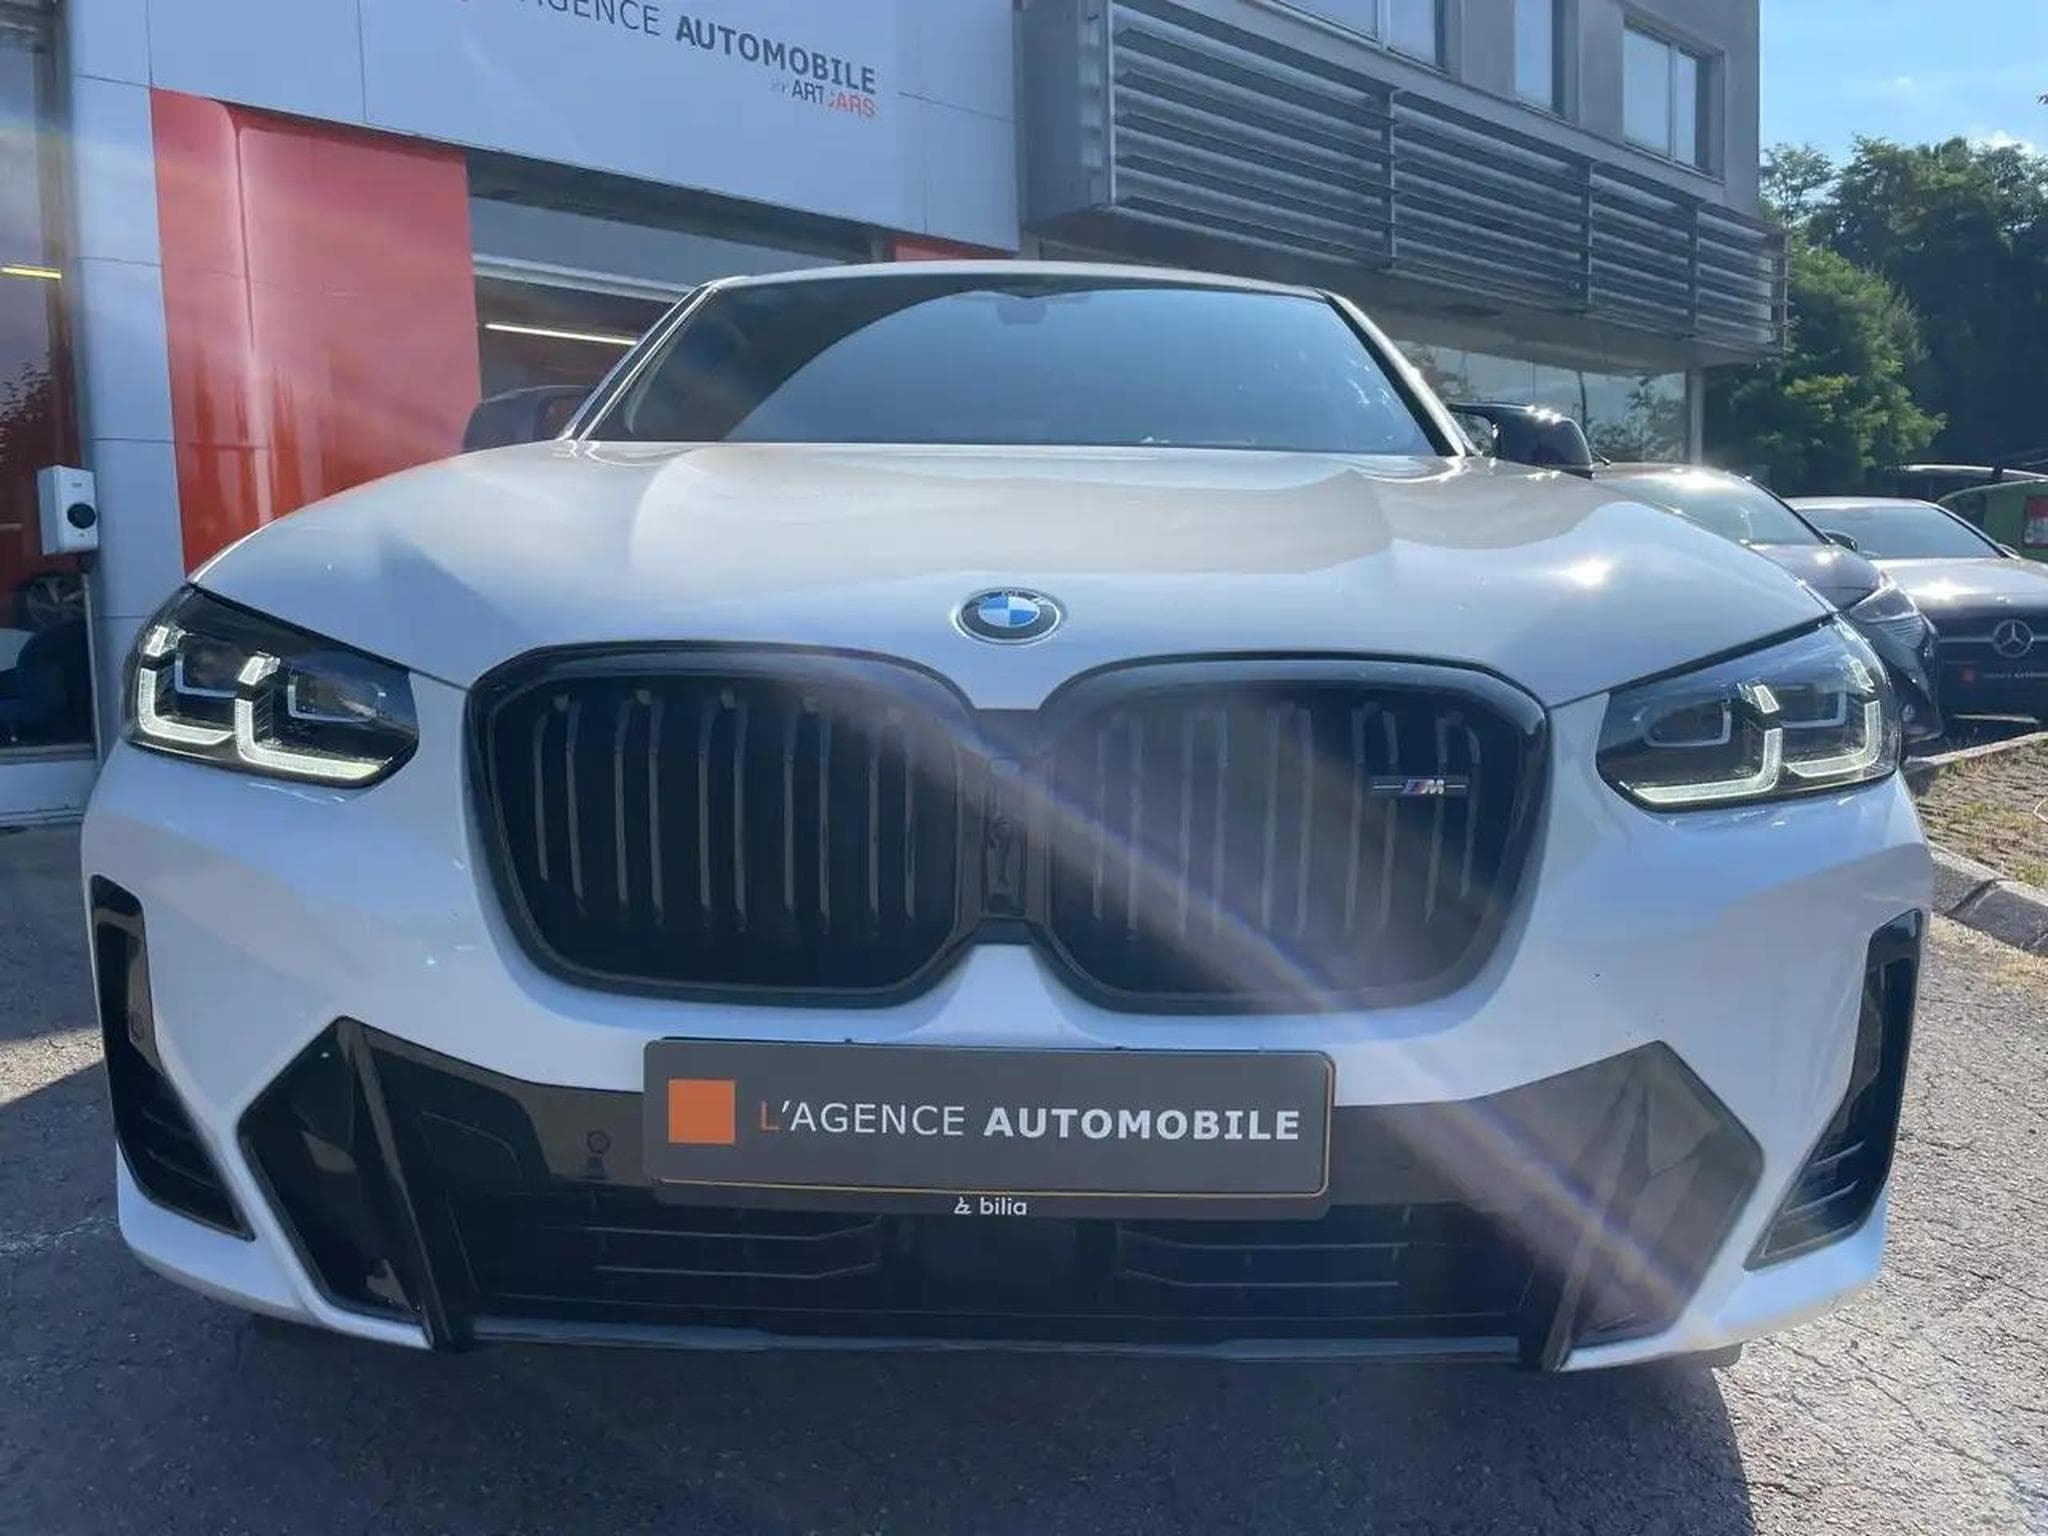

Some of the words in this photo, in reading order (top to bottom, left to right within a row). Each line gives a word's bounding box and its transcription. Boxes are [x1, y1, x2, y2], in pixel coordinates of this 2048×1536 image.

[520, 0, 661, 36] ENCE
[676, 15, 876, 94] AUTOMOBILE
[792, 79, 825, 105] ART
[760, 1100, 965, 1136] L'AGENCE
[983, 1107, 1300, 1140] AUTOMOBILE
[979, 1197, 1027, 1216] bilia
